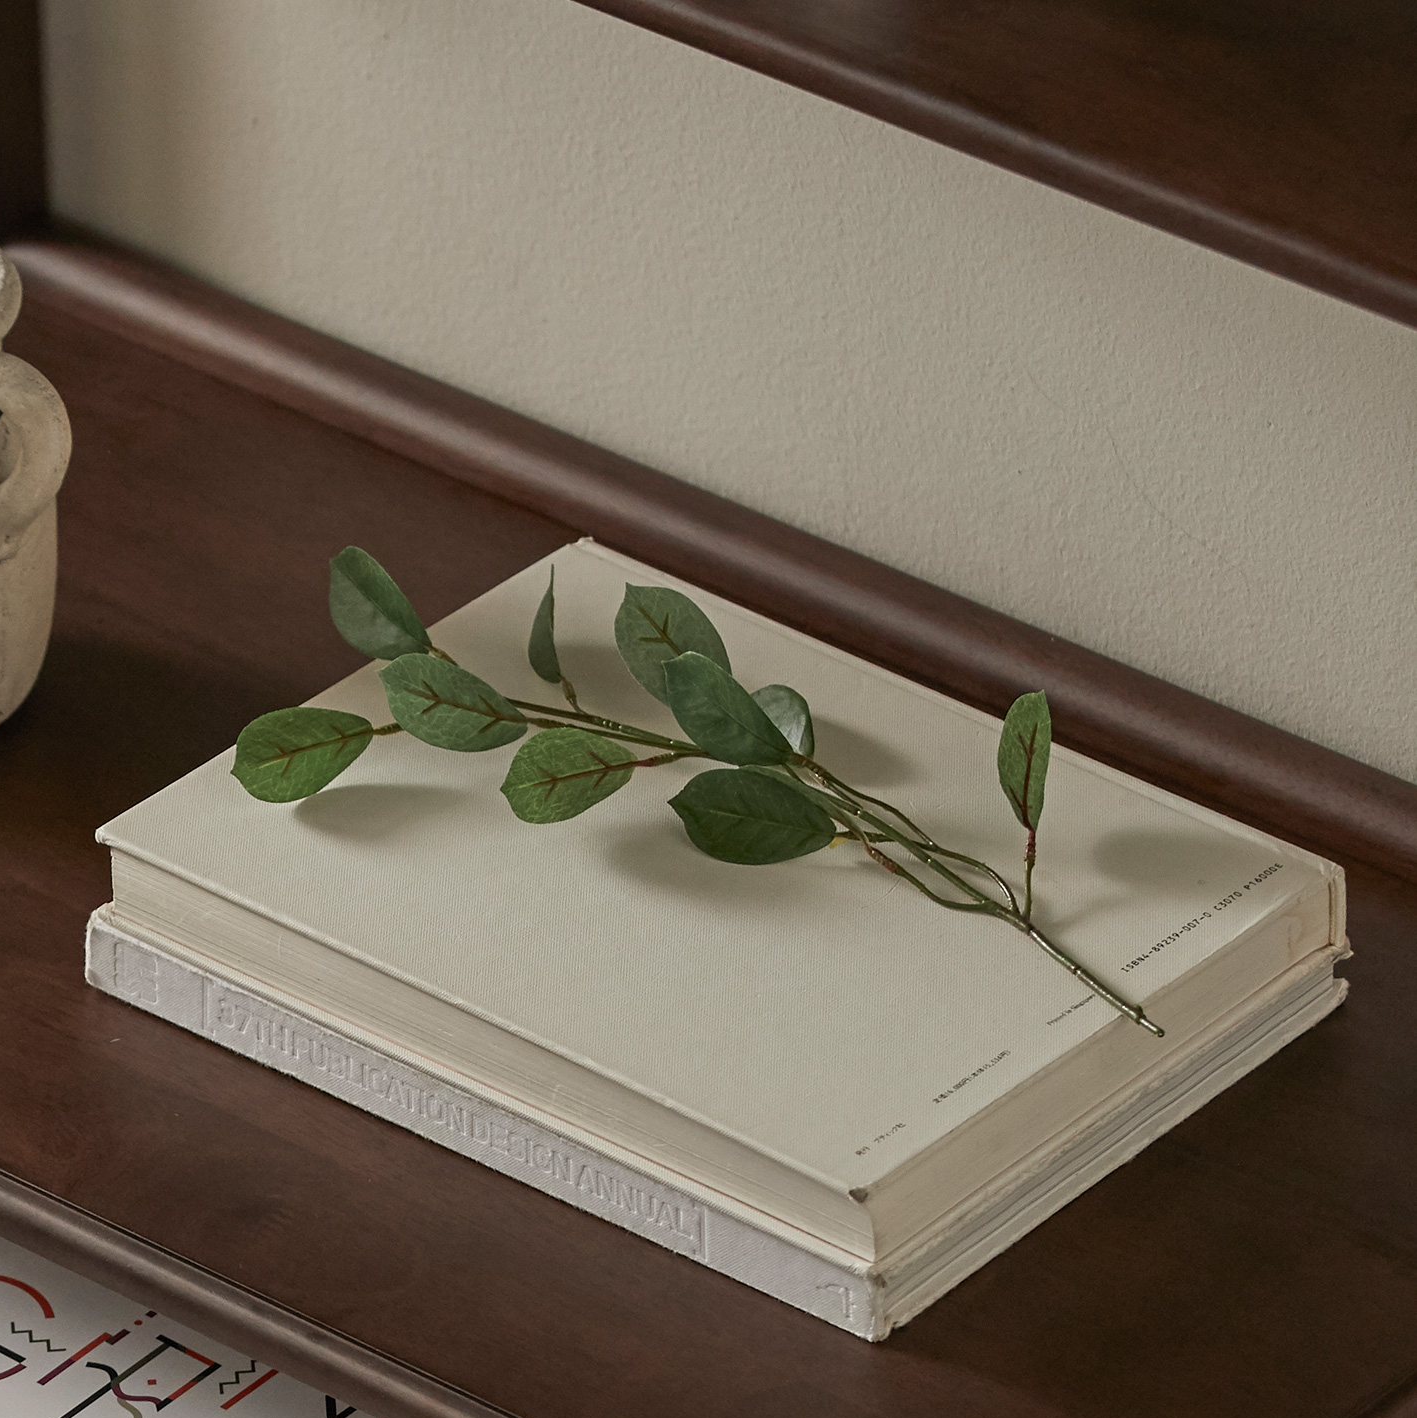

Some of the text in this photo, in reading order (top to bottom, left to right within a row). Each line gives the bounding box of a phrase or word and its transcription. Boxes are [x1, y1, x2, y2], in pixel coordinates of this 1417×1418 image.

[1120, 862, 1283, 973] ISBN4-89239-007-0 C3070 P16000E
[291, 1030, 468, 1137] PUBLICATION
[470, 1111, 573, 1186] DESIGN
[577, 1163, 694, 1240] ANNUAL
